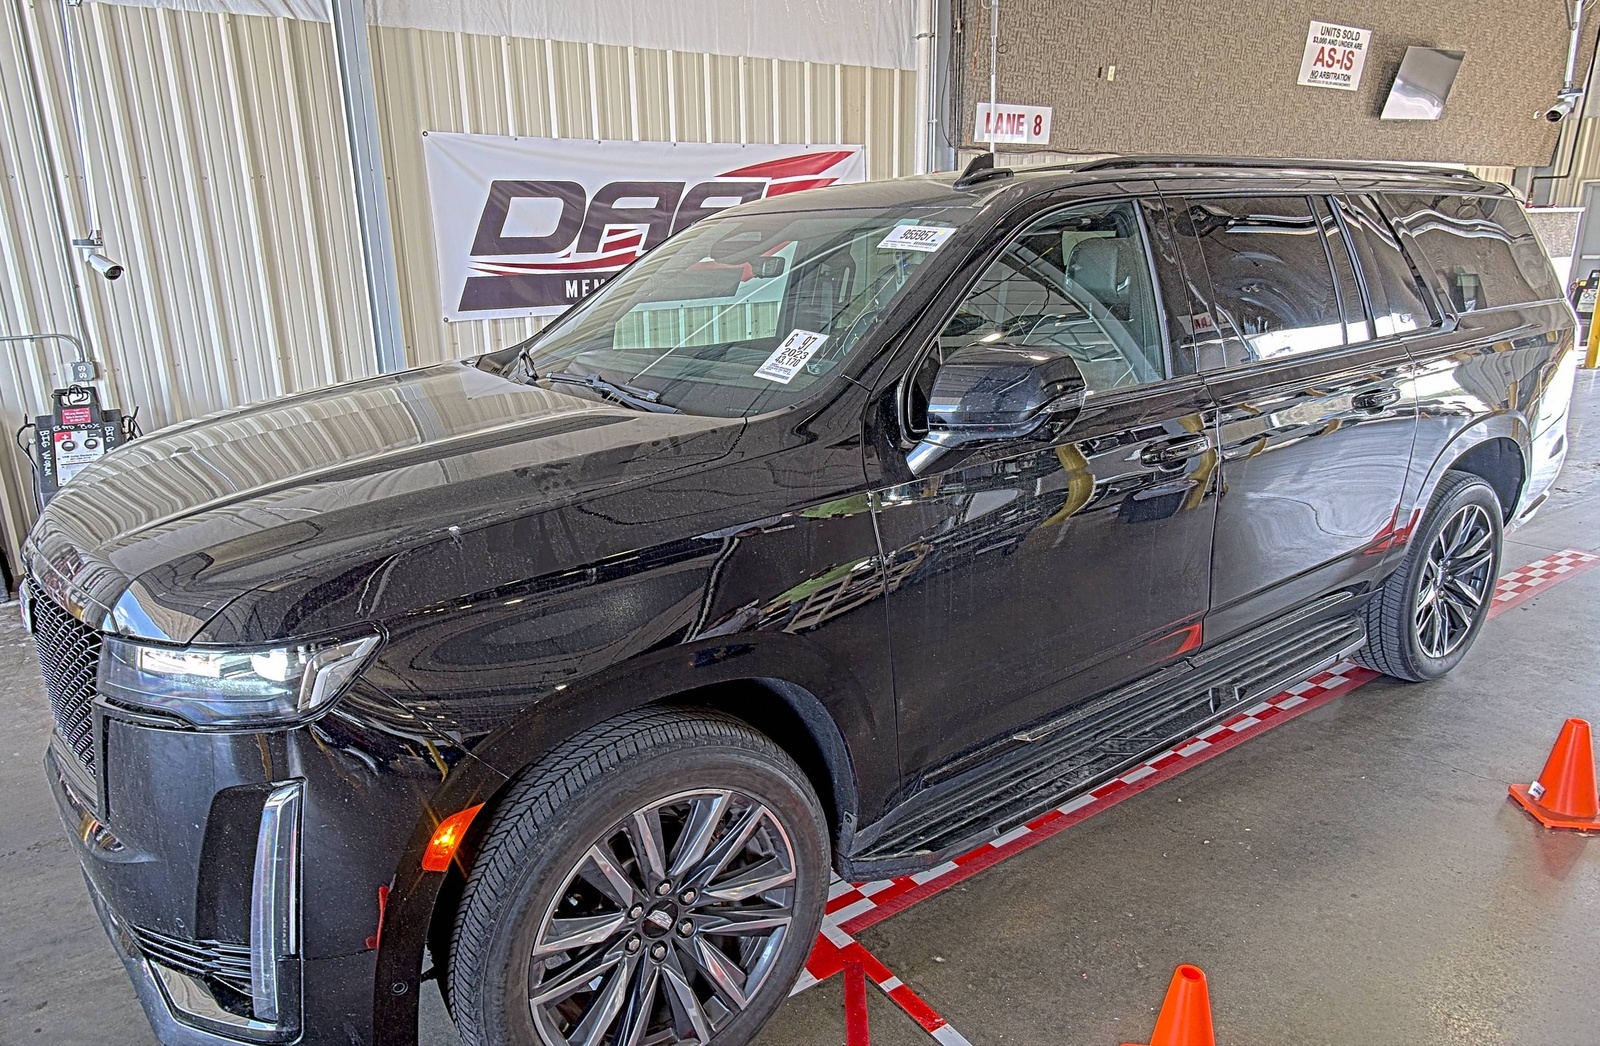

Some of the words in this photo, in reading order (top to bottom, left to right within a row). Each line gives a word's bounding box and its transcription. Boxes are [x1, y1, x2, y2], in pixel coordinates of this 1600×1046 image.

[1320, 26, 1341, 38] UNITS
[1342, 29, 1361, 41] SOLD
[1312, 36, 1327, 45] $3,000
[1327, 38, 1338, 47] AND
[1338, 40, 1354, 48] UNDER
[1353, 42, 1363, 50] ARE
[1313, 46, 1355, 71] AS-IS
[1310, 70, 1319, 79] NO
[1319, 71, 1352, 82] ARBITRATION
[984, 112, 1025, 135] LANE
[1033, 114, 1043, 136] 8
[899, 229, 937, 241] 955957
[785, 333, 799, 347] 6
[798, 335, 818, 351] 97
[775, 355, 801, 367] 43,170
[781, 347, 809, 360] 2023
[39, 430, 50, 448] BIG
[104, 426, 115, 443] BIG
